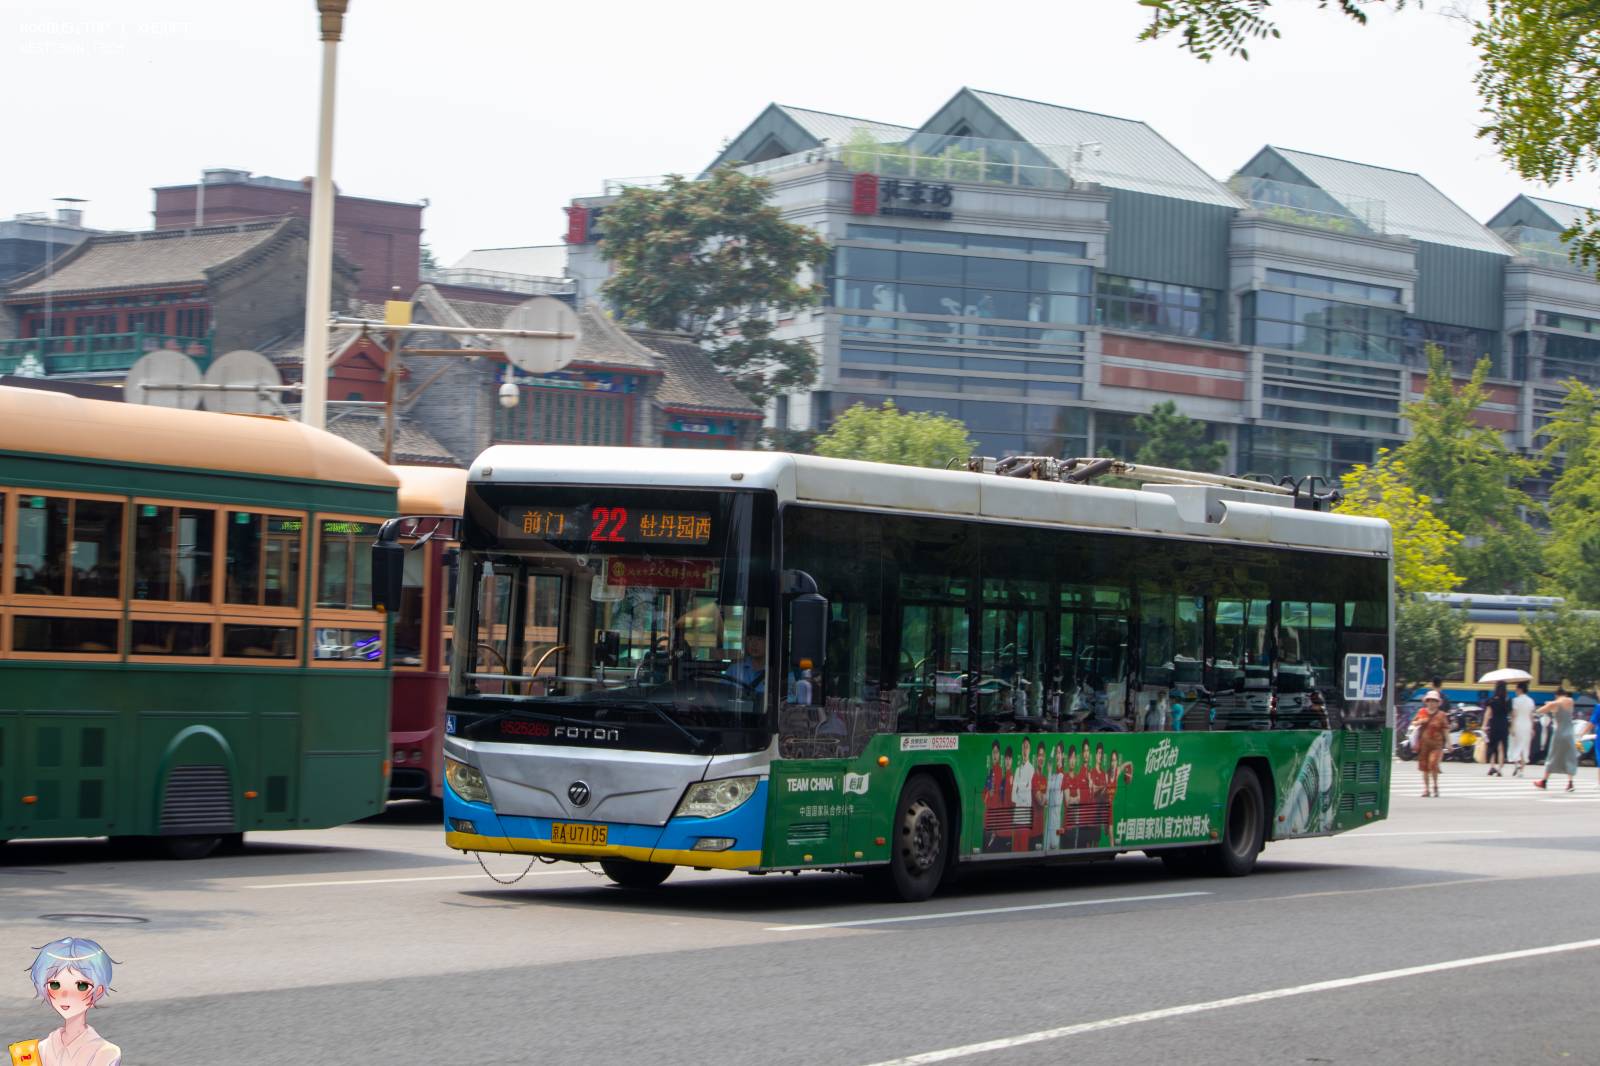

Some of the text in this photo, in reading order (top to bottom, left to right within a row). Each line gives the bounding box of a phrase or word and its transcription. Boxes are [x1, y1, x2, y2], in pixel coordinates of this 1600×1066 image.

[522, 507, 712, 542] 前门 22 牡丹园西
[1144, 737, 1179, 775] 你我的
[787, 777, 834, 792] TEAM CHINA
[1117, 814, 1210, 841] 中国国家队官方饮用水
